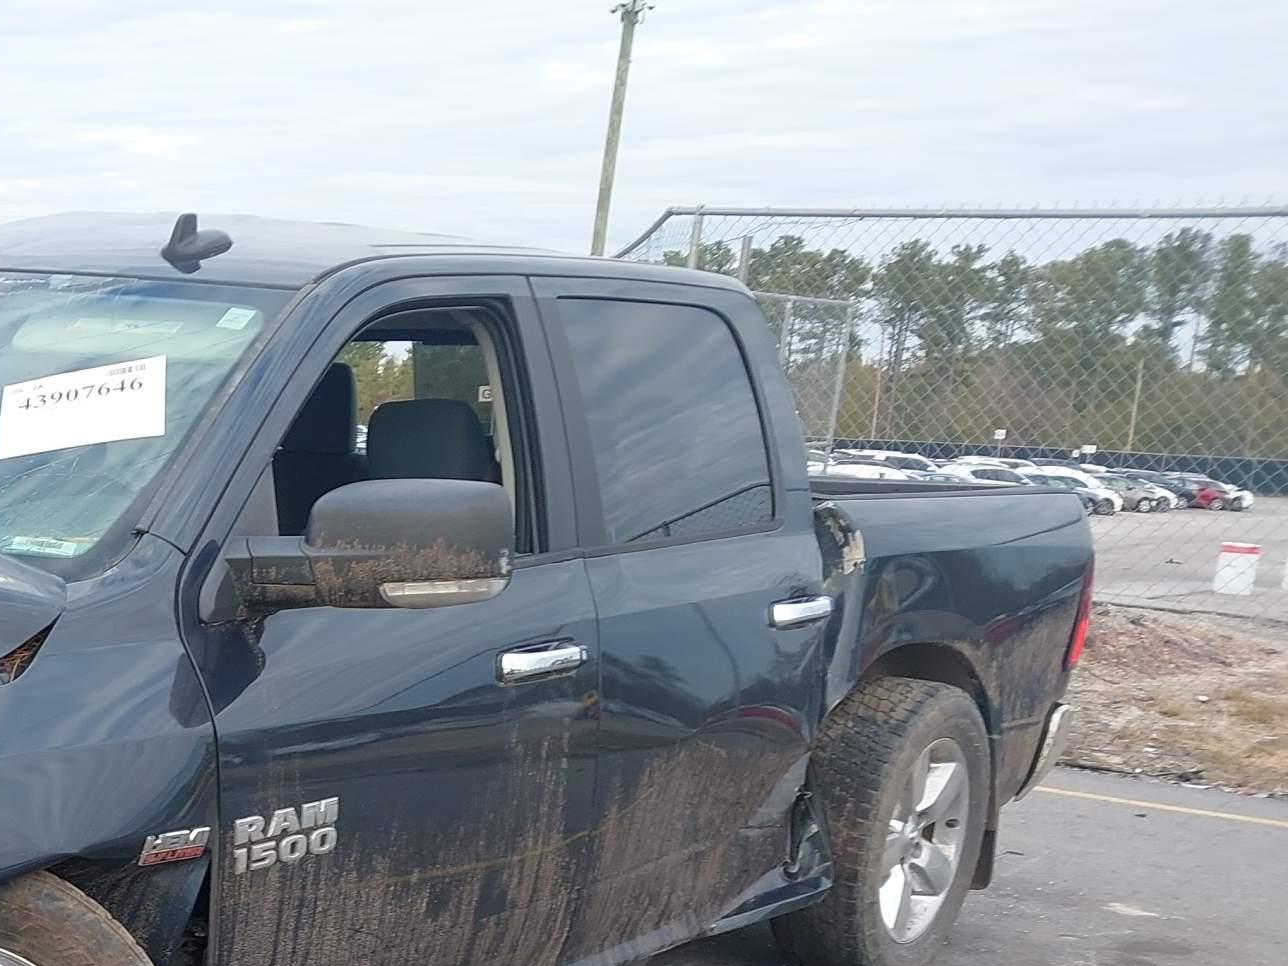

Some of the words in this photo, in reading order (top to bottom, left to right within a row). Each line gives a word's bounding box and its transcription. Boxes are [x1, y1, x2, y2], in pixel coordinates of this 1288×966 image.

[18, 376, 143, 410] 43907646
[233, 796, 339, 846] RAM
[233, 826, 338, 875] 1500
